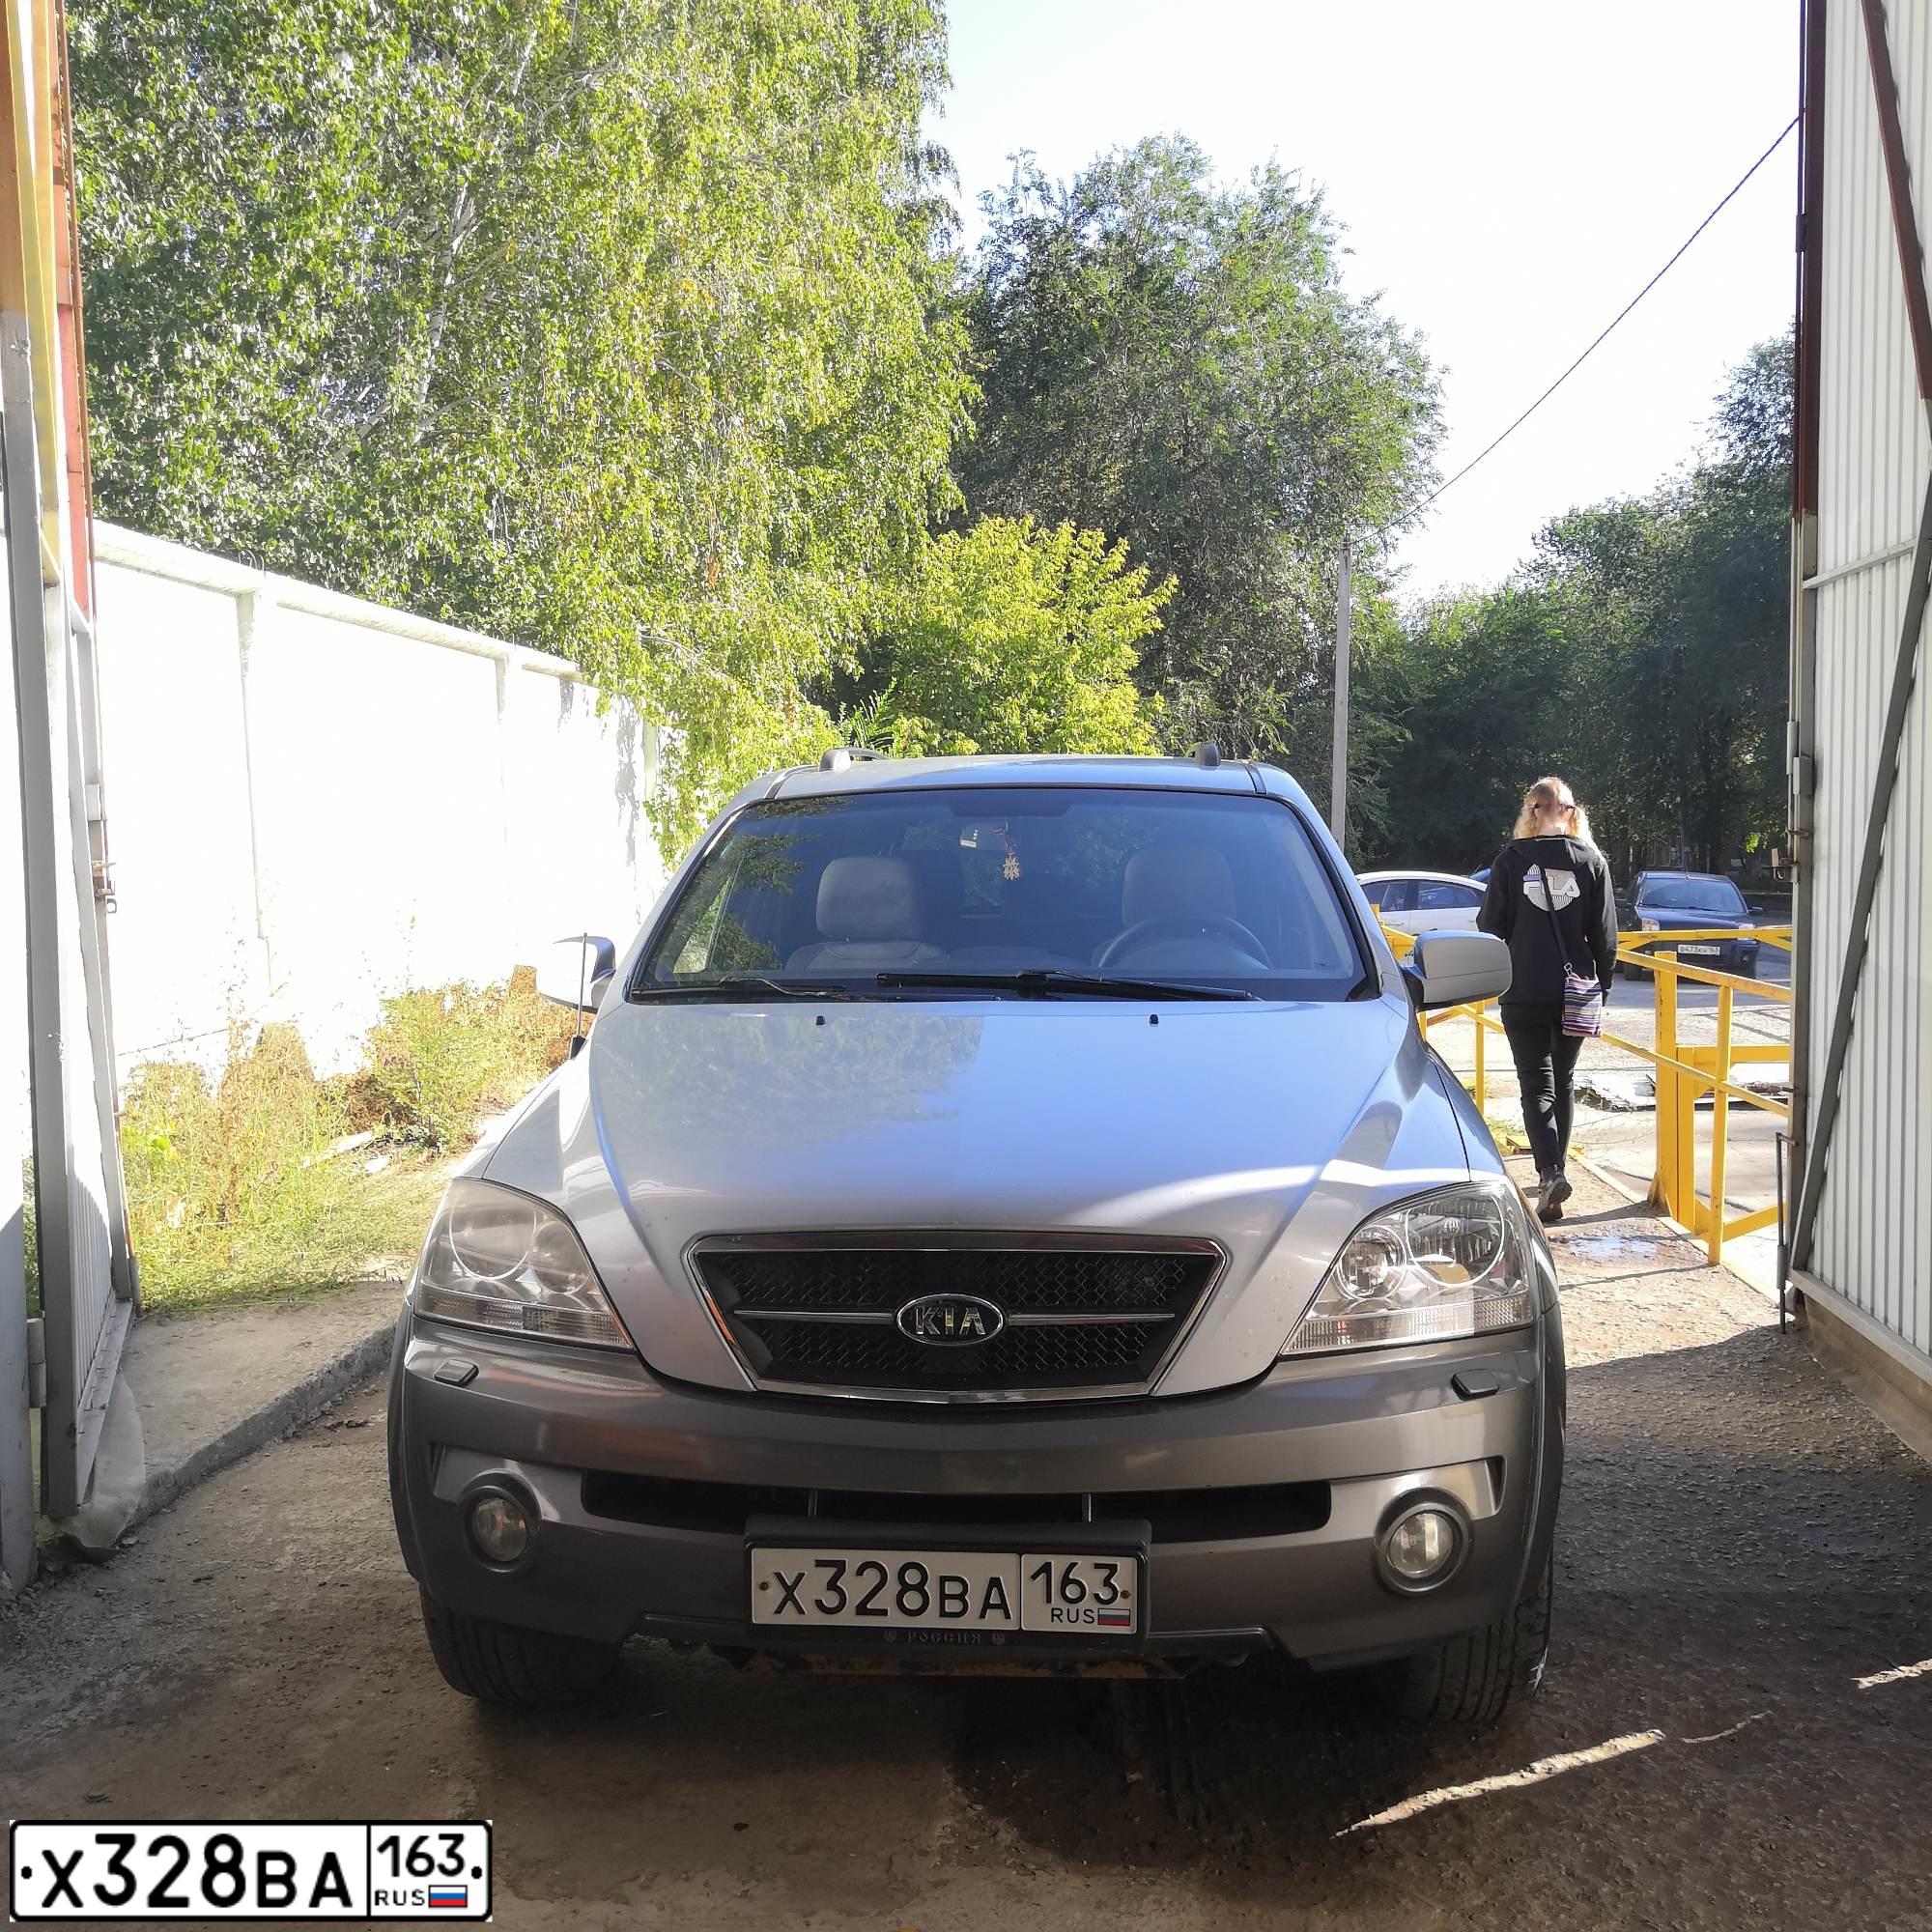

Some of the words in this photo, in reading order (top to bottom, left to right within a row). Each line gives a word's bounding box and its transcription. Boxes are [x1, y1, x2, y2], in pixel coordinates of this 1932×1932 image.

[915, 1306, 986, 1335] KIA
[774, 1559, 1011, 1620] Х328ВА
[1031, 1561, 1121, 1605] 163
[1050, 1607, 1095, 1624] RUS
